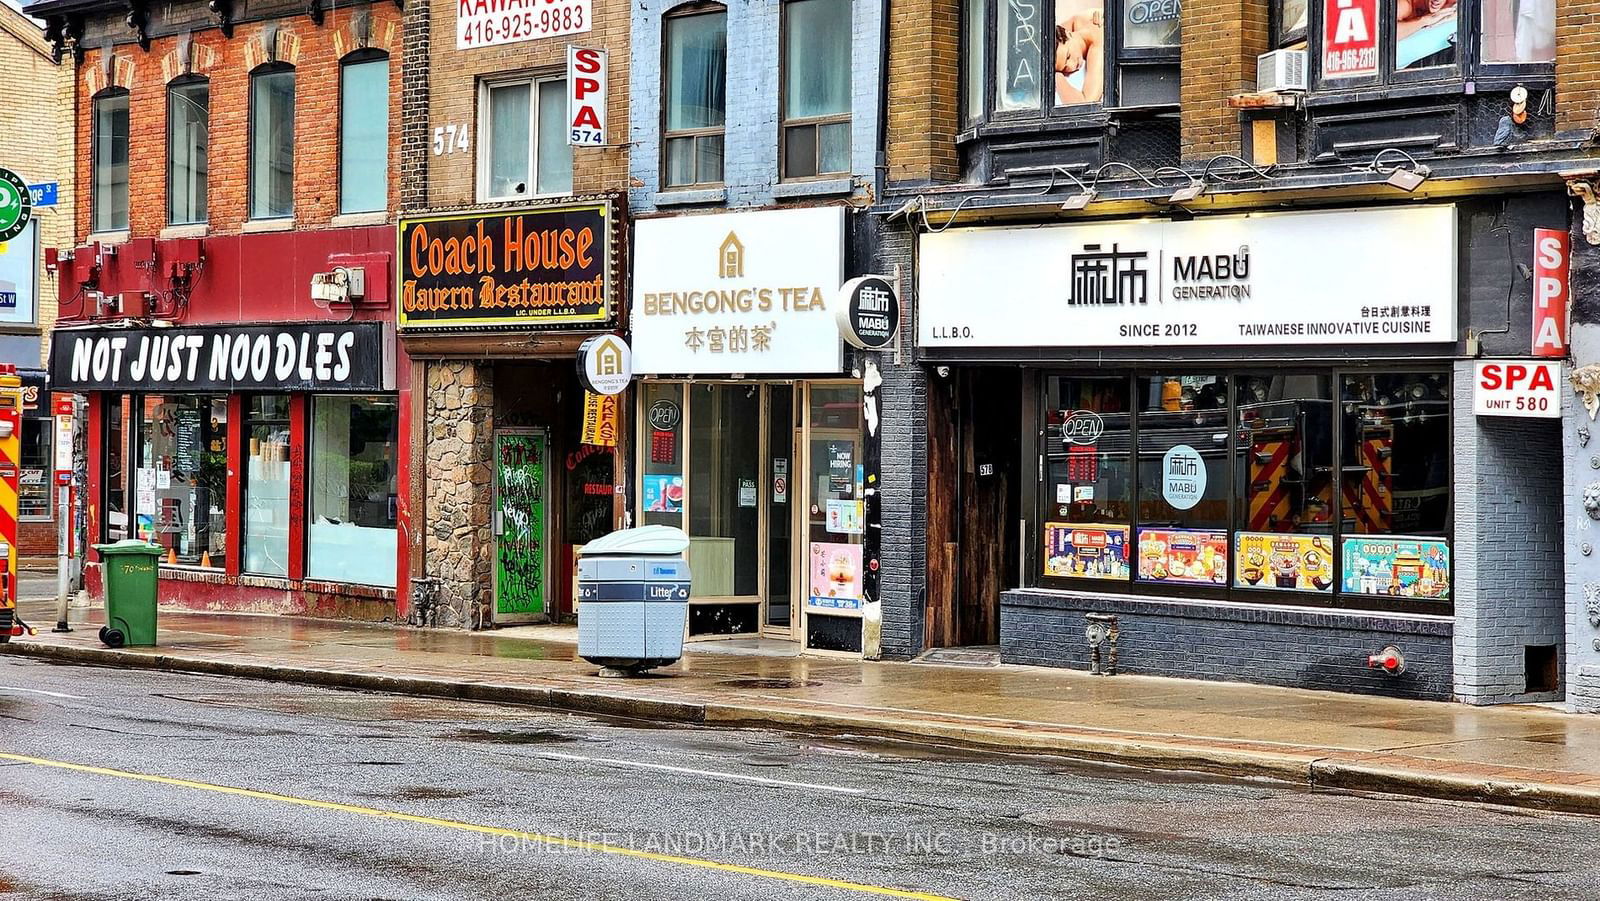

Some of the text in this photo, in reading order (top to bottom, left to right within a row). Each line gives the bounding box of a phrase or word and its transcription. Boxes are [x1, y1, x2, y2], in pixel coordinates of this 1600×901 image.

[464, 5, 583, 44] 416-925-9883
[1326, 48, 1376, 71] 416-966-2317
[573, 50, 602, 129] SPA
[434, 124, 468, 156] 574
[572, 130, 602, 143] 574
[410, 216, 593, 278] Coach House
[403, 274, 603, 312] Tavern Restaurant
[643, 286, 827, 316] BENGONG'S TEA
[1172, 285, 1250, 300] GENERATION
[1534, 237, 1563, 349] SPA
[858, 329, 889, 338] GENERATION
[932, 326, 974, 339] L.L.B.O.
[1119, 323, 1198, 337] SINCE 2012
[1239, 321, 1431, 336] TAIWANESE INNOVATIVE CUISINE
[684, 325, 772, 354] 本宮的茶
[71, 331, 355, 382] NOT JUST NOODLES
[1481, 364, 1554, 391] SPA
[1486, 397, 1548, 411] UNIT 580
[651, 407, 676, 423] OPEN
[1065, 419, 1100, 435] OPEN
[830, 460, 852, 468] HIRING
[650, 586, 672, 597] Litter
